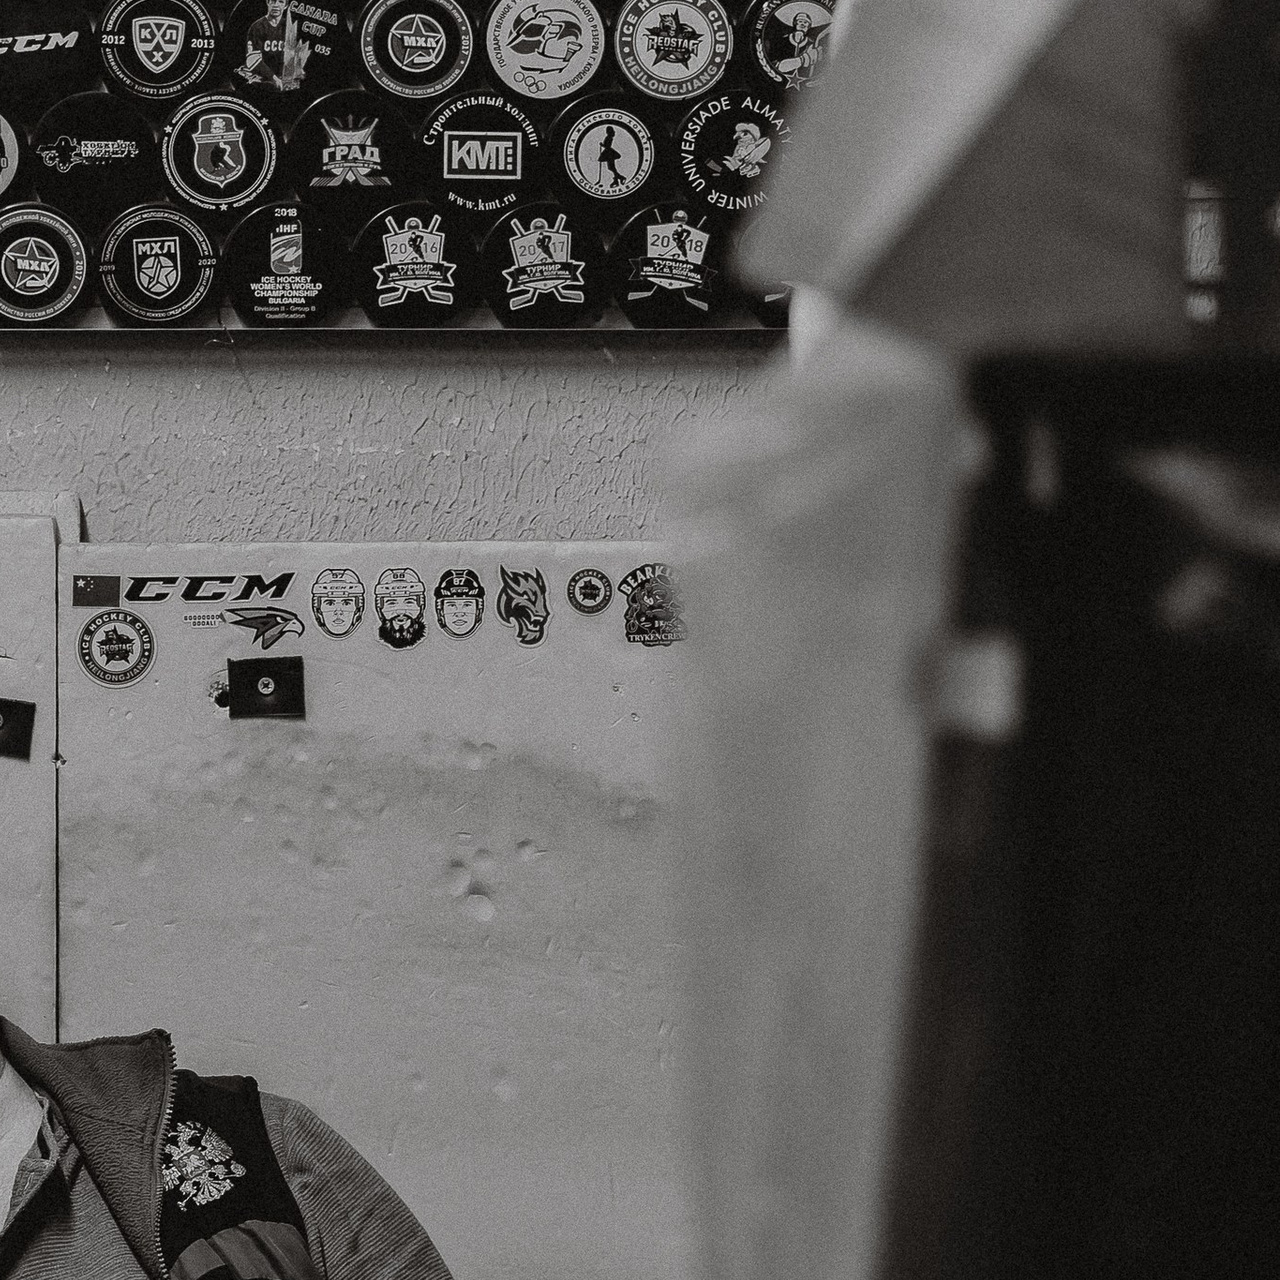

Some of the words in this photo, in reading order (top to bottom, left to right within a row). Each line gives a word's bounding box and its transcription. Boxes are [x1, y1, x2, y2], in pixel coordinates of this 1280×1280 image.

[288, 0, 338, 26] CANADA
[301, 21, 327, 37] CUP
[621, 12, 638, 42] ICE
[707, 10, 726, 53] CLUB
[101, 35, 125, 45] 2012
[191, 39, 215, 49] 2013
[403, 35, 437, 48] МХЛ
[647, 35, 699, 55] REDSTAR
[625, 54, 719, 94] HEILONGJIANG
[423, 96, 502, 146] Строительный
[504, 101, 539, 148] холдинг
[680, 96, 732, 193] UNIVERSIADE
[323, 145, 381, 163] ГРАД
[448, 191, 517, 211] www.kmt.ru
[707, 189, 769, 210] WINTER
[274, 208, 298, 217] 2018
[137, 241, 175, 256] МХЛ
[17, 259, 49, 272] МХЛ
[198, 258, 216, 266] 2020
[397, 263, 433, 273] ТУРНИР
[526, 264, 561, 274] ТУРНИР
[254, 290, 318, 298] CHAMPIONSHIP
[124, 572, 296, 602] CCM
[82, 633, 90, 653] ICE
[89, 612, 133, 629] HOCKEY
[135, 622, 150, 649] CLUB
[86, 657, 148, 681] HEILONGJIANG
